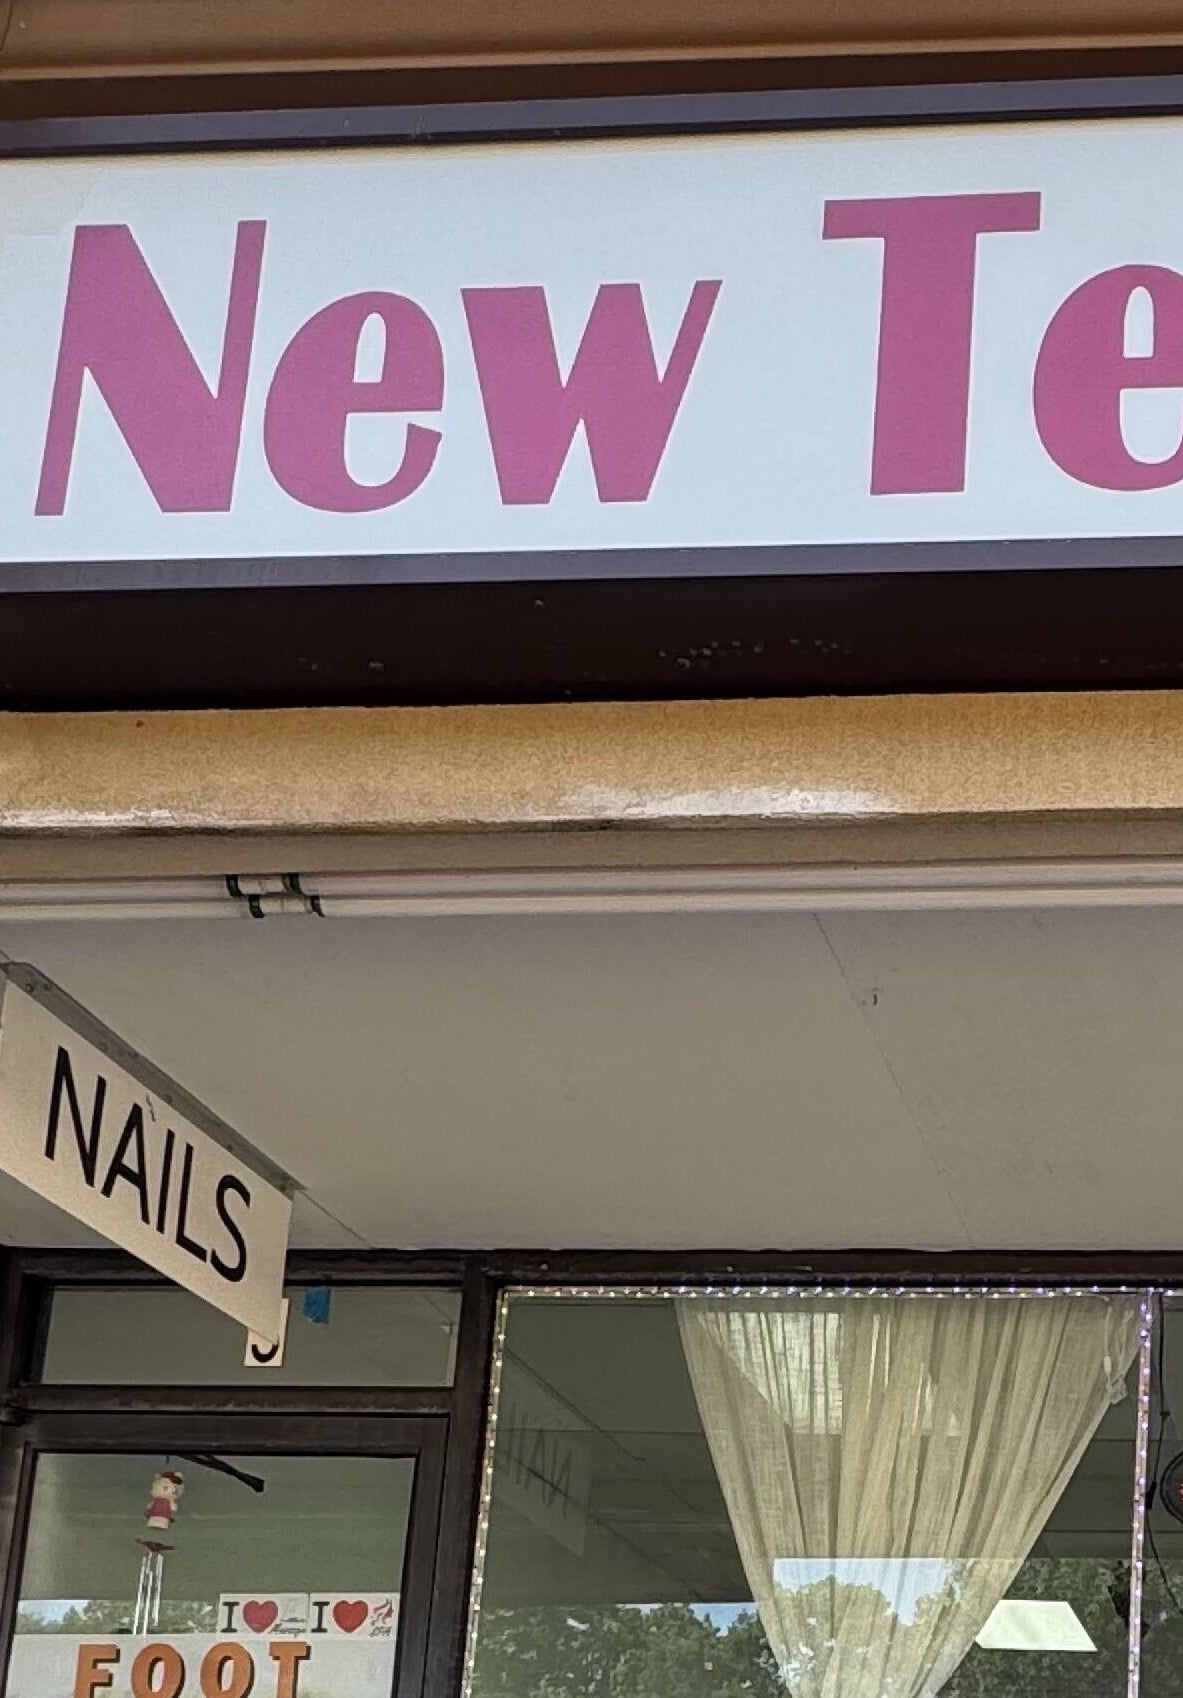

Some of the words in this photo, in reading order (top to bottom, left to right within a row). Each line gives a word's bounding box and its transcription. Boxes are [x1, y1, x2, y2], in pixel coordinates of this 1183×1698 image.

[33, 218, 724, 516] New
[44, 1045, 251, 1283] NAILS
[73, 1642, 311, 1698] FOOT
